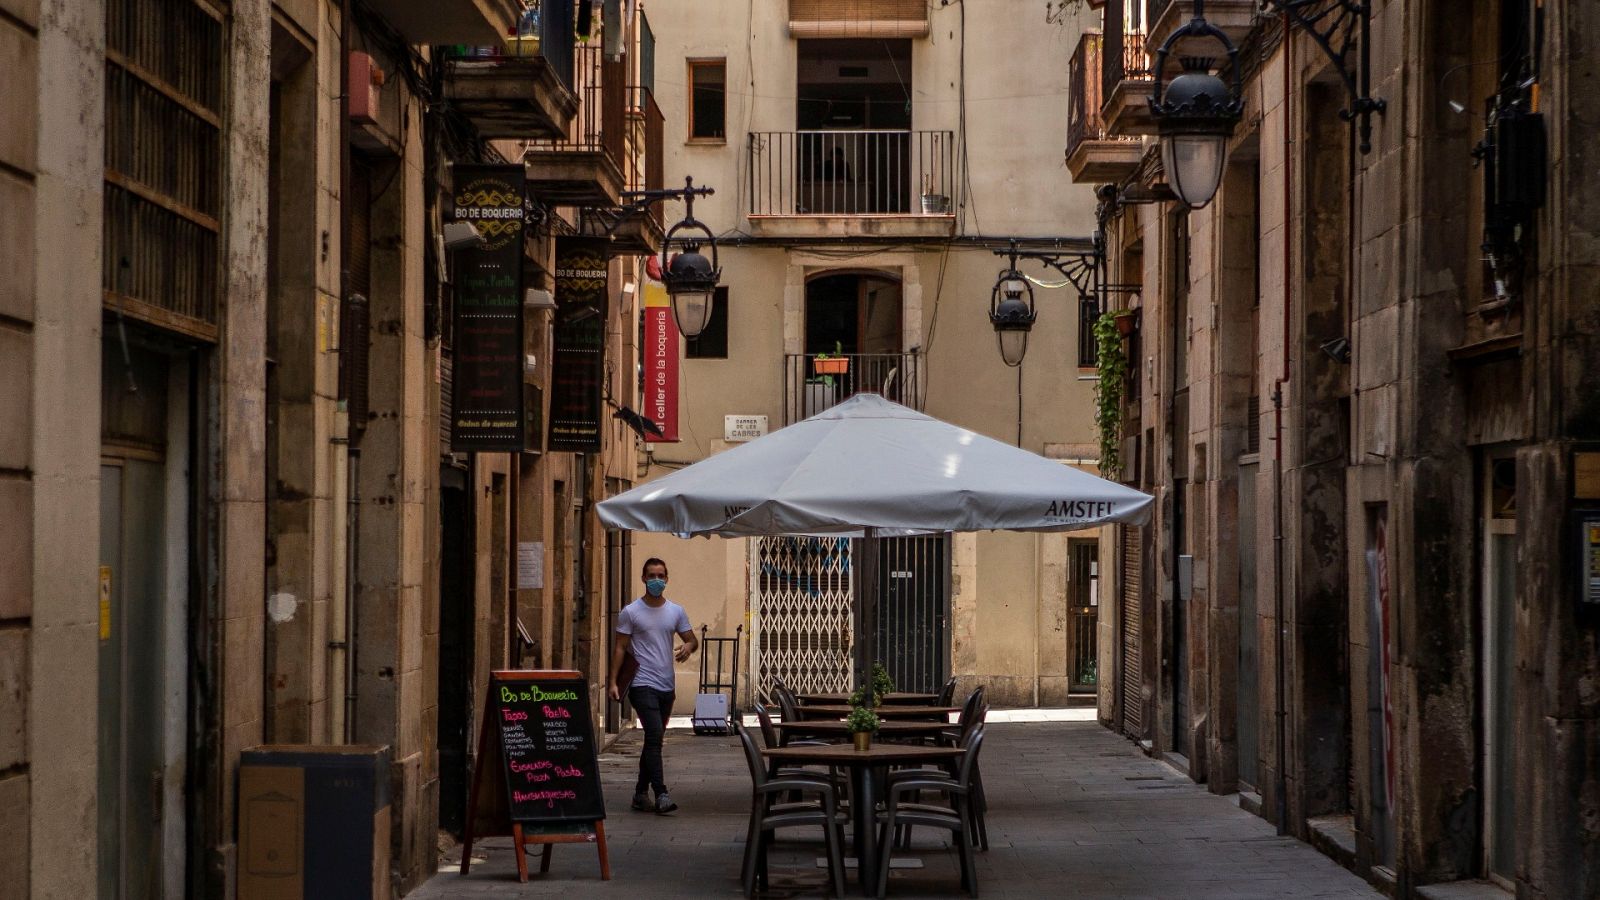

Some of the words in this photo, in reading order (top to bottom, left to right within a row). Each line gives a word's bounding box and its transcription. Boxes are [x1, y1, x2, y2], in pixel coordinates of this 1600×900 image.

[455, 208, 468, 218] BO
[469, 208, 480, 218] DE
[481, 208, 523, 219] BOQUERIA
[556, 269, 566, 277] BO
[566, 270, 575, 278] DE
[575, 270, 607, 279] BOQUERIA
[655, 311, 668, 356] boqueria
[655, 360, 665, 370] la
[655, 372, 665, 385] de
[655, 387, 665, 419] celler
[501, 686, 518, 703] Bo
[501, 709, 528, 725] Tapas
